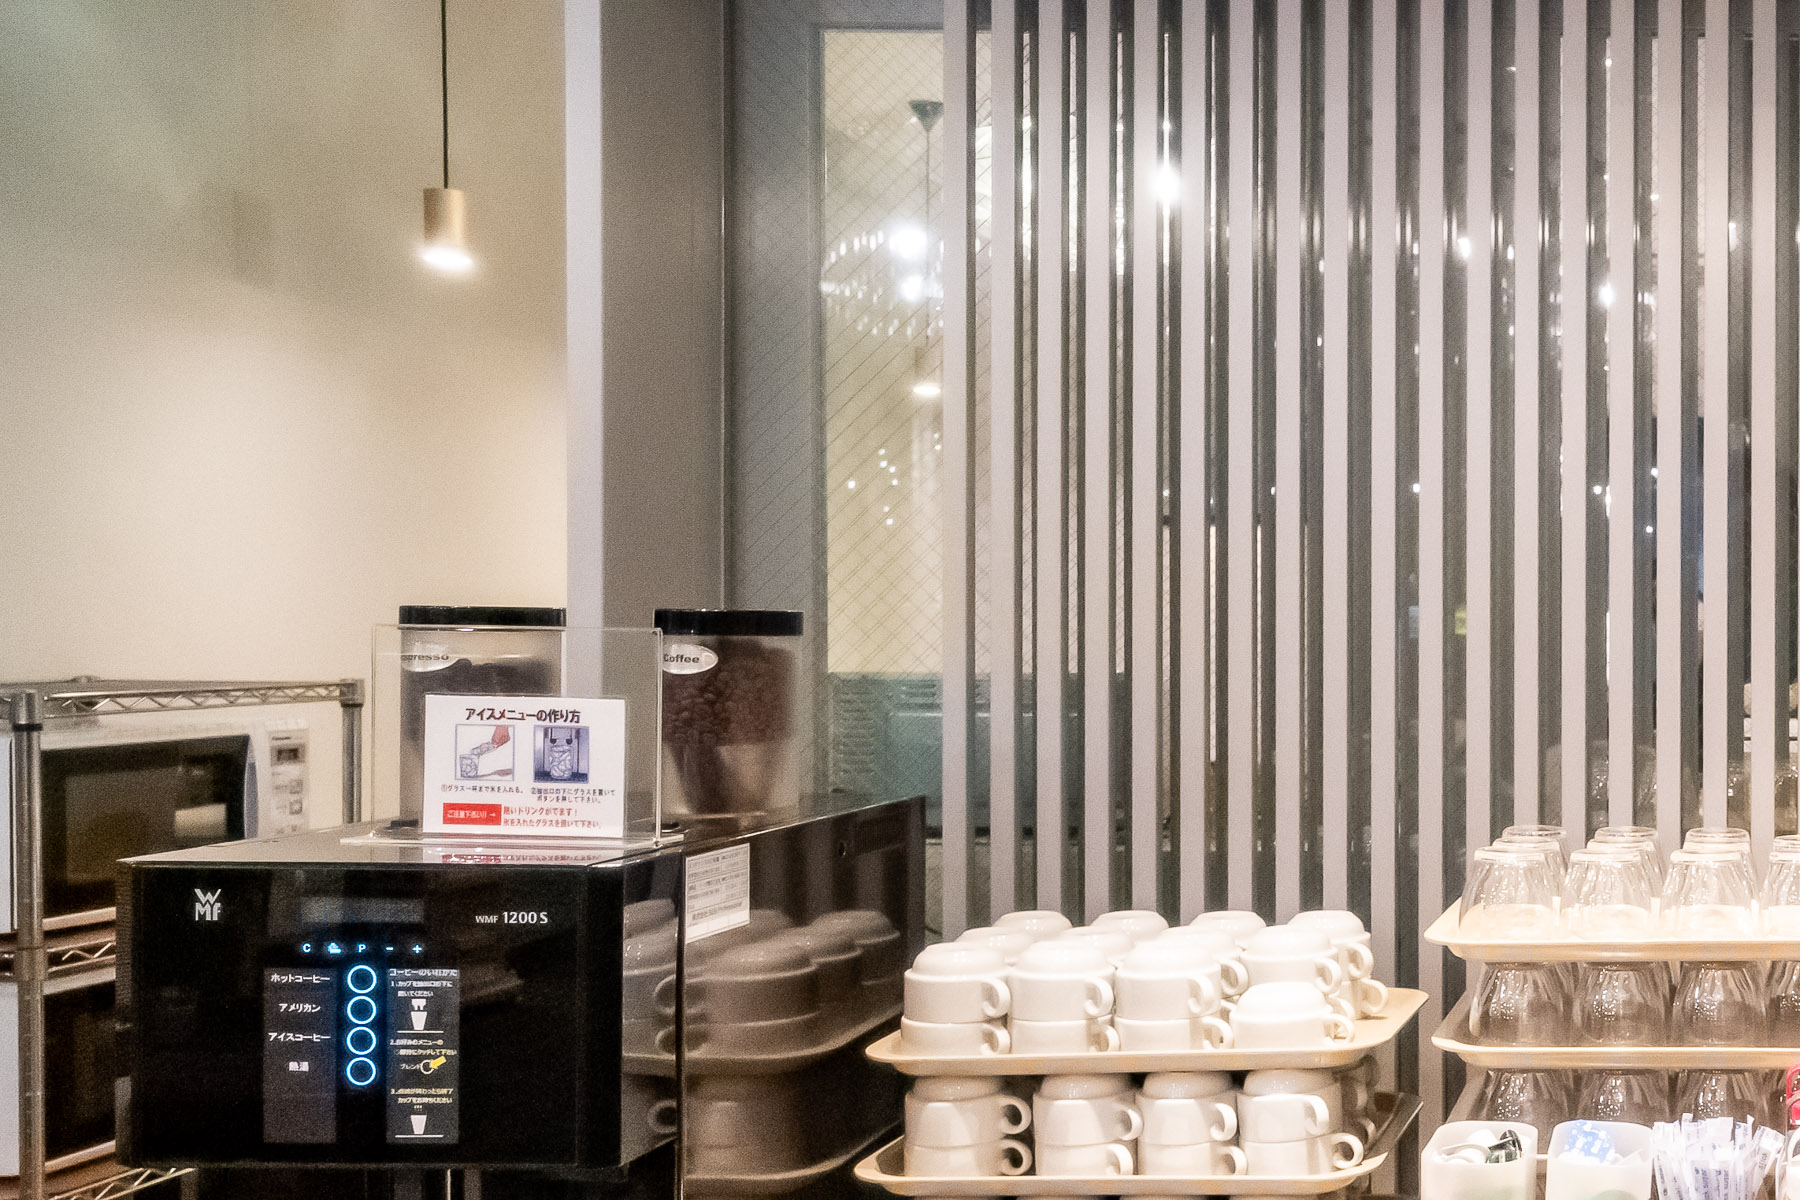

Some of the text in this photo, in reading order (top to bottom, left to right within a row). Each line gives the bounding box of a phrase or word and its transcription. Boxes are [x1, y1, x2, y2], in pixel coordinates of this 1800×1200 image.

[465, 707, 581, 724] アイスメニューの作り方
[475, 914, 499, 924] WMF
[270, 973, 331, 984] ホットコーヒー
[278, 1003, 321, 1013] アメリカン
[268, 1032, 332, 1042] アイスコーヒー
